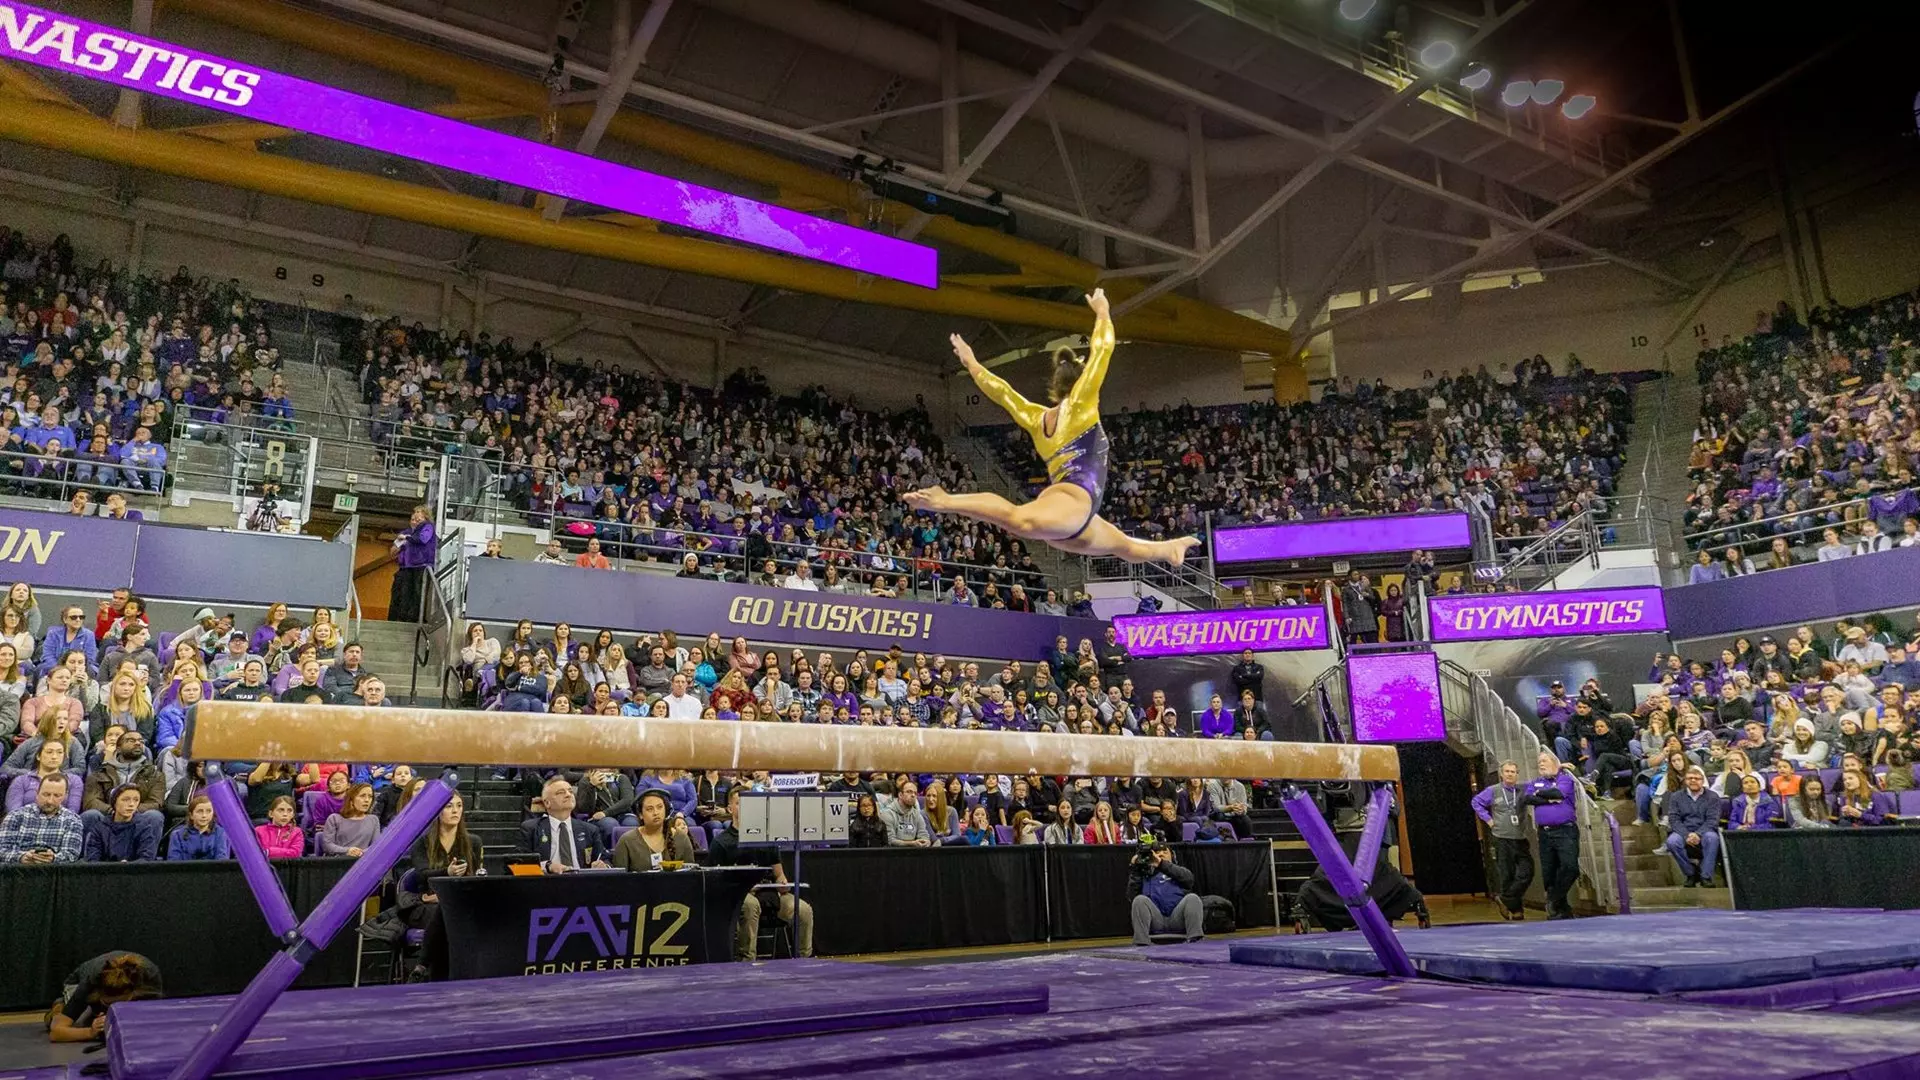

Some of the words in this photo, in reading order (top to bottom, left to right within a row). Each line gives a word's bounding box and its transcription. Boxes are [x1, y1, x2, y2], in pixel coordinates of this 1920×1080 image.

[0, 5, 260, 107] NASTICS
[276, 266, 287, 280] 8
[312, 274, 324, 287] 9
[1693, 324, 1706, 338] 11
[1631, 336, 1649, 347] 10
[966, 395, 979, 405] 10
[339, 495, 355, 508] EXIT
[1335, 561, 1350, 572] EXIT
[728, 596, 774, 625] GO
[777, 600, 933, 639] HUSKIES!
[1455, 600, 1644, 630] GYMNASTICS
[1126, 616, 1319, 648] WASHINGTON
[773, 777, 805, 786] ROBERSON
[806, 775, 816, 785] W
[830, 804, 843, 815] W
[525, 958, 690, 976] CONFERENCE
